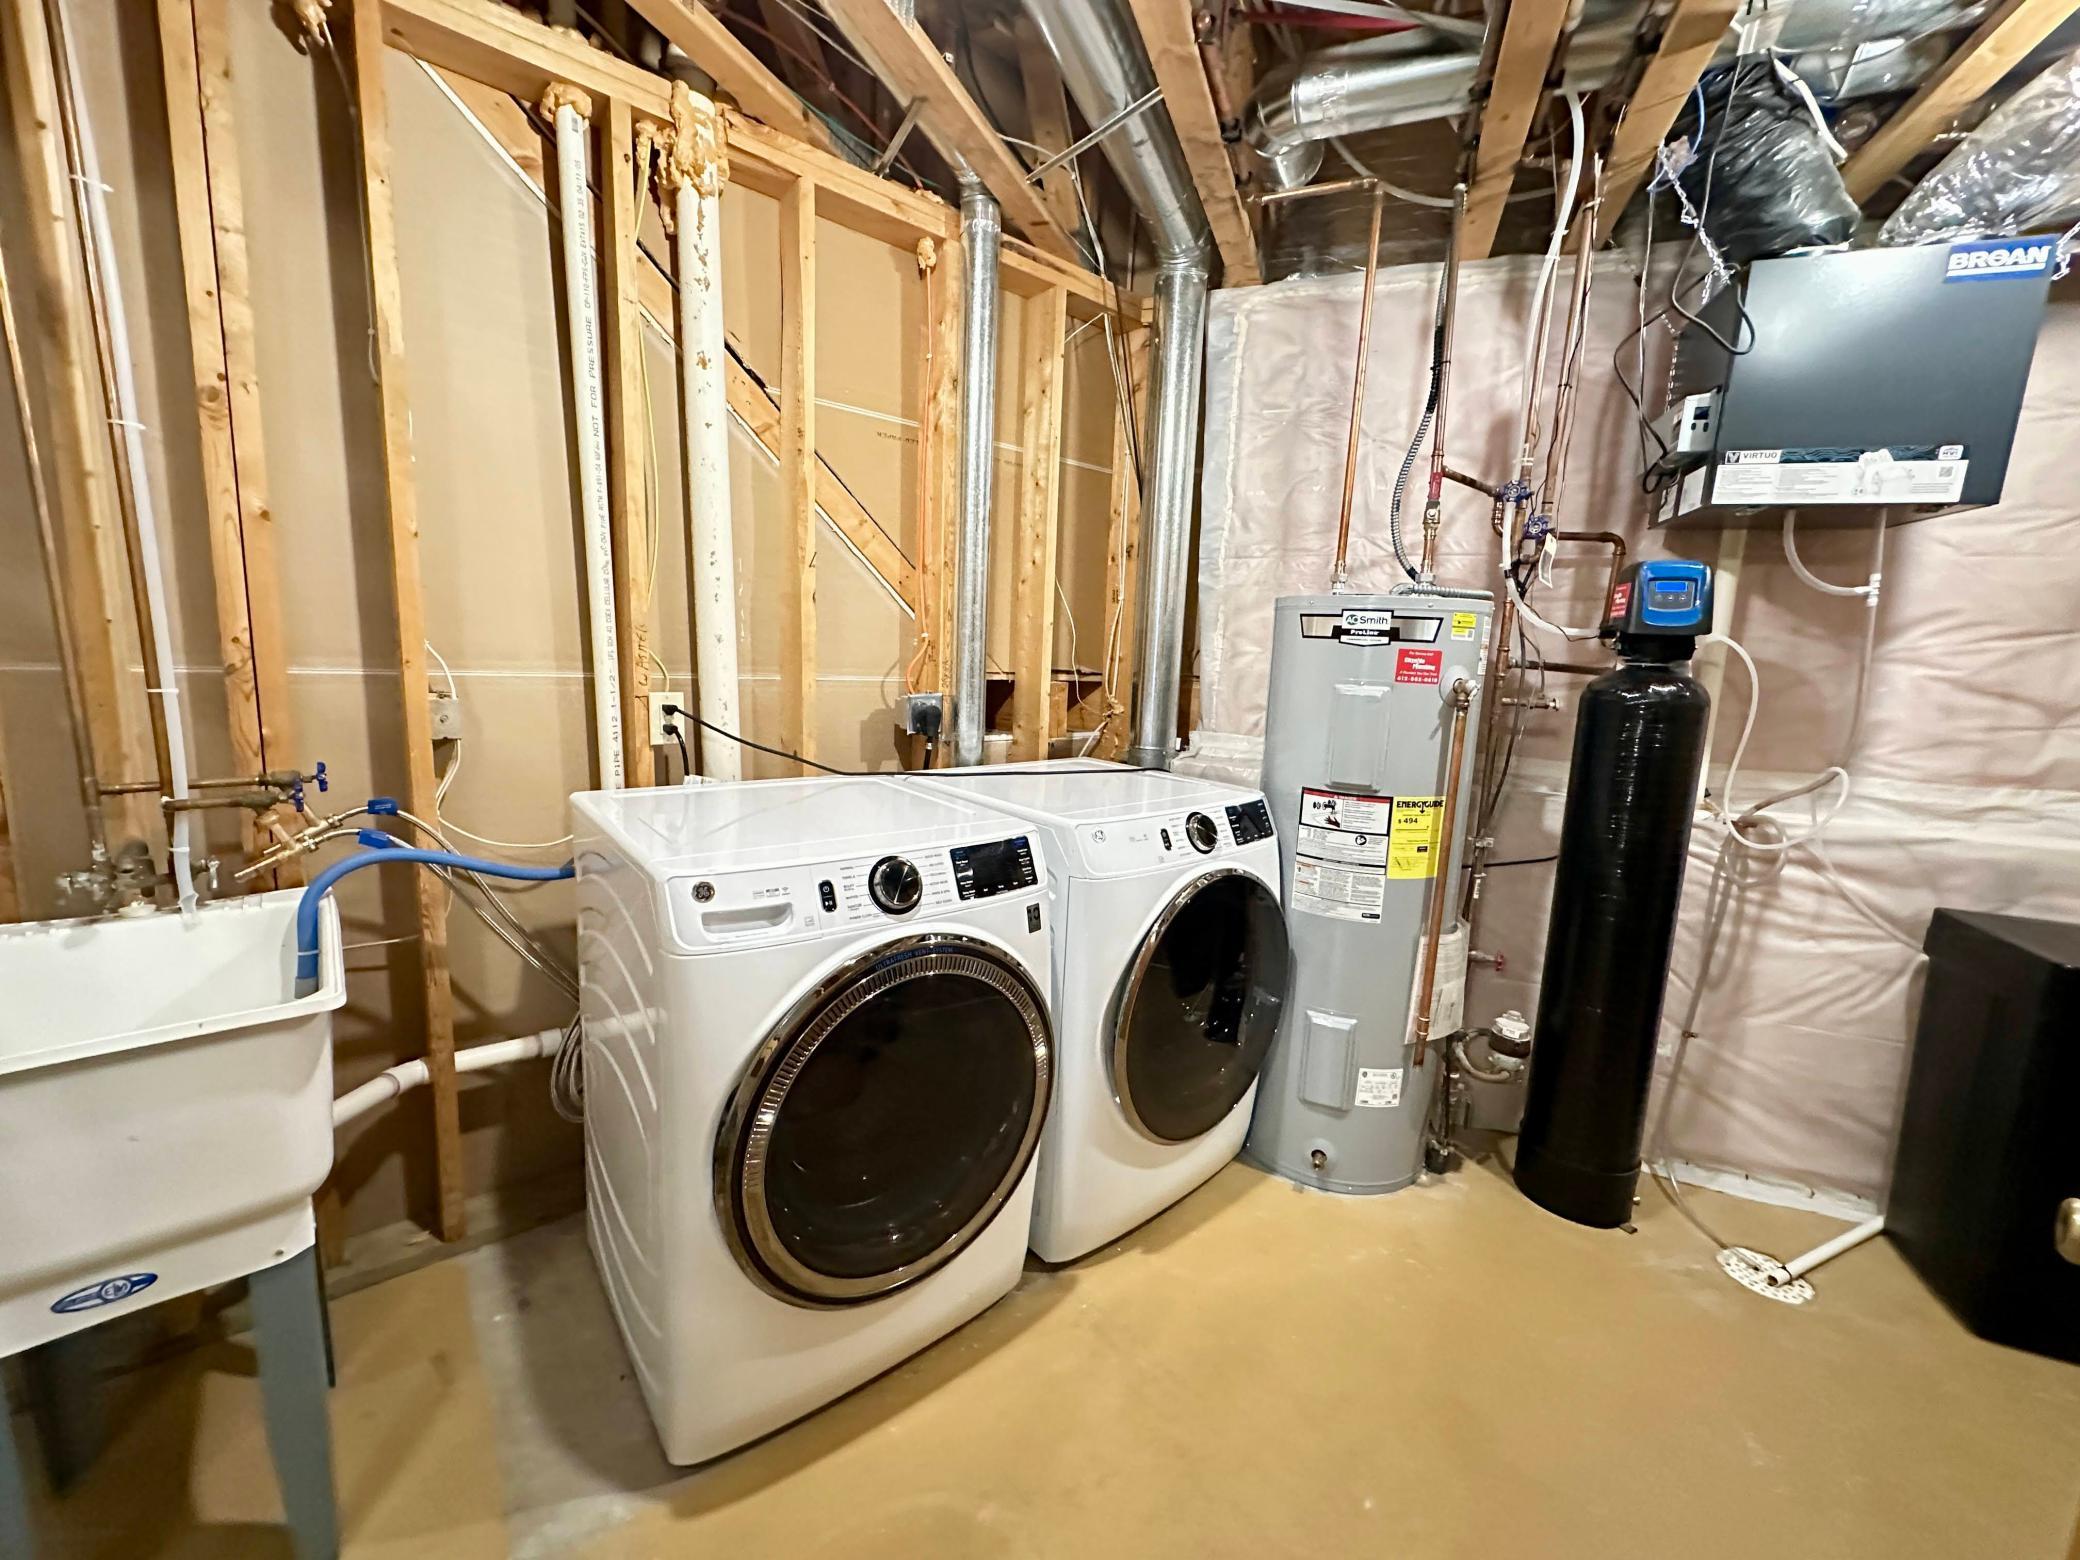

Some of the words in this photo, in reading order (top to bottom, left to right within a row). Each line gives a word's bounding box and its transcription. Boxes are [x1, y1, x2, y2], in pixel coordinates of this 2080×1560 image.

[1947, 245, 2052, 270] BROAN
[585, 315, 596, 379] PRESSURE
[589, 385, 598, 409] FOR
[591, 415, 600, 437] NOT
[1359, 616, 1388, 625] Smith
[611, 715, 619, 743] 4112
[613, 750, 621, 777] PIPE
[1396, 800, 1445, 810] ENERGYGUIDE
